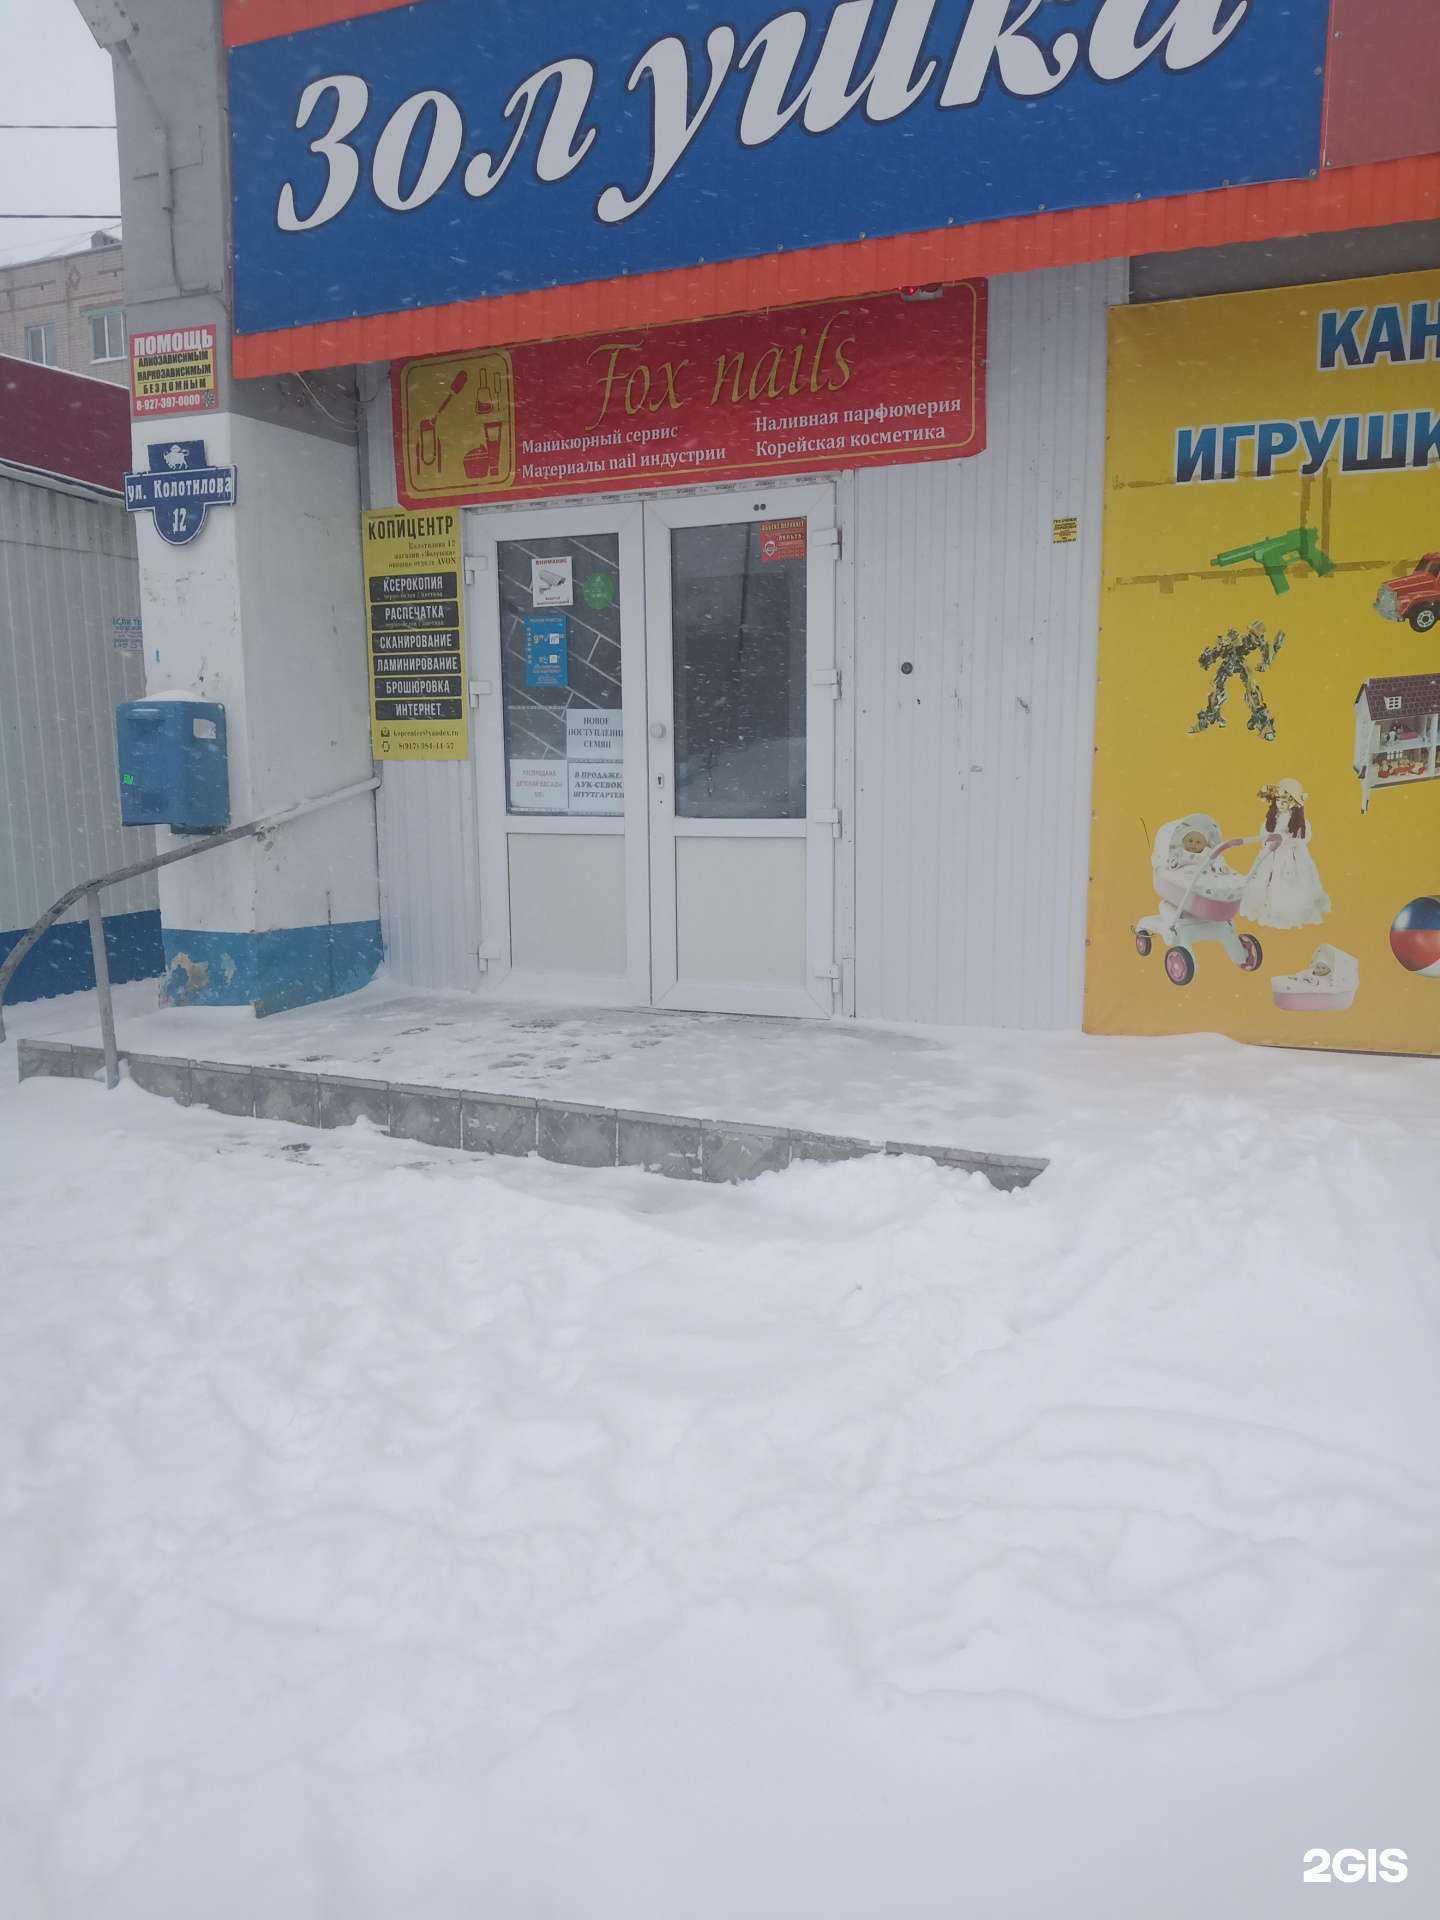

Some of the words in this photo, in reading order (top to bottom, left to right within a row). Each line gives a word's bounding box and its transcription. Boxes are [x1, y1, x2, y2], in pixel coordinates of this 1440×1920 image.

[275, 0, 1249, 231] Золушка
[134, 329, 214, 357] ПОМОЩЬ
[1319, 302, 1440, 369] КАН
[137, 364, 212, 382] НАРКОЗАВИСИМЫМ
[584, 340, 691, 430] Fox
[710, 309, 856, 406] nails
[143, 378, 207, 395] БЕЗДОМНЫМ
[755, 411, 839, 433] Наливная
[843, 399, 961, 426] парфюмерия
[522, 430, 622, 454] Маникюрный
[625, 424, 679, 446] сервис
[756, 435, 845, 458] Корейская
[850, 426, 945, 448] косметика
[1176, 411, 1440, 483] ИГРУШК
[522, 459, 605, 480] Материалы
[609, 453, 636, 471] nail
[640, 447, 726, 469] индустрии
[127, 485, 147, 502] ул.
[154, 477, 232, 499] Колотилова
[172, 507, 187, 534] 12
[368, 515, 454, 541] КОПИЦЕНТР
[383, 576, 443, 593] КСЕРОКОПИЯ
[385, 605, 445, 621] РАСПЕЧАТКА
[380, 633, 453, 649] СКАНИРОВАНИЕ
[376, 656, 458, 673] ЛАМИНИРОВАНИЕ
[386, 680, 450, 695] БРОШЮРОВКА
[395, 703, 442, 717] ИНТЕРНЕТ
[583, 716, 608, 726] НОВОЕ
[583, 740, 611, 750] СЕМЯН
